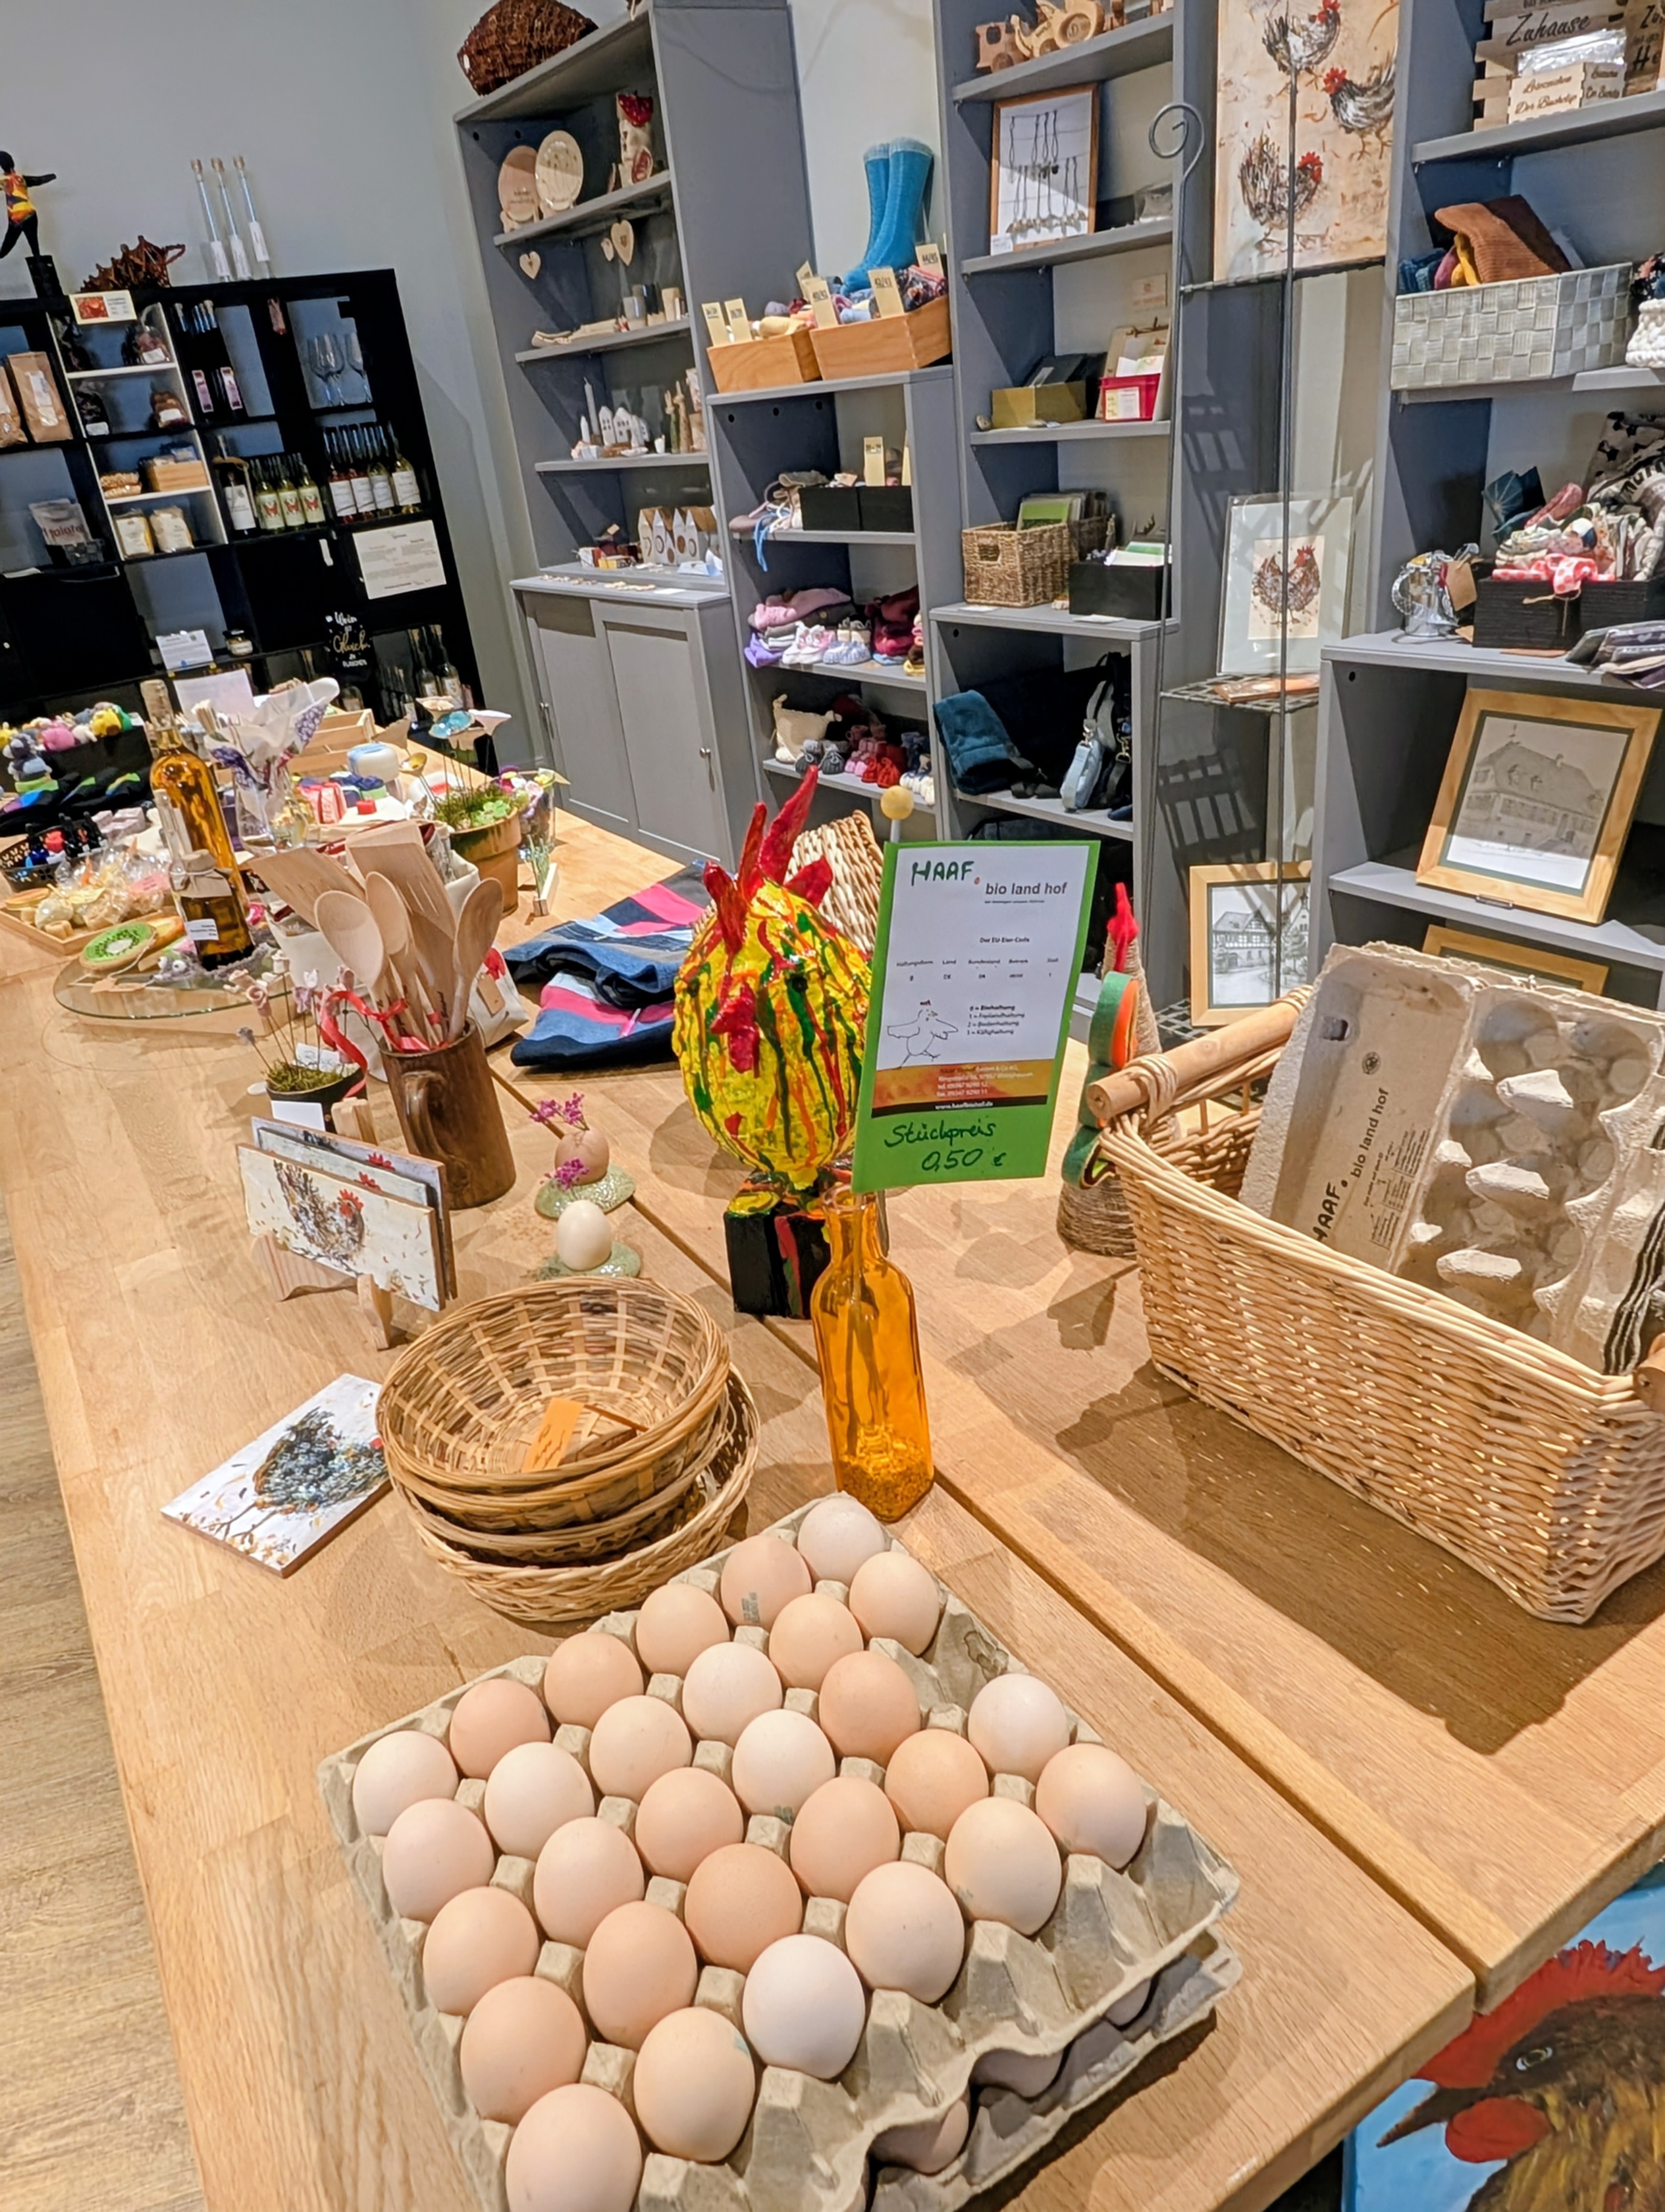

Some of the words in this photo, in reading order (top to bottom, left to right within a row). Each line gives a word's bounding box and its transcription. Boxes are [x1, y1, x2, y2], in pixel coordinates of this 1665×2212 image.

[1506, 12, 1591, 46] Zuhause
[986, 883, 1007, 895] bio
[1011, 883, 1041, 895] land
[1044, 882, 1068, 895] hof
[884, 1118, 996, 1148] Stückpreis
[1350, 1154, 1366, 1178] bio
[1359, 1117, 1379, 1151] land
[1371, 1087, 1389, 1114] hof
[922, 1148, 984, 1172] 0,50
